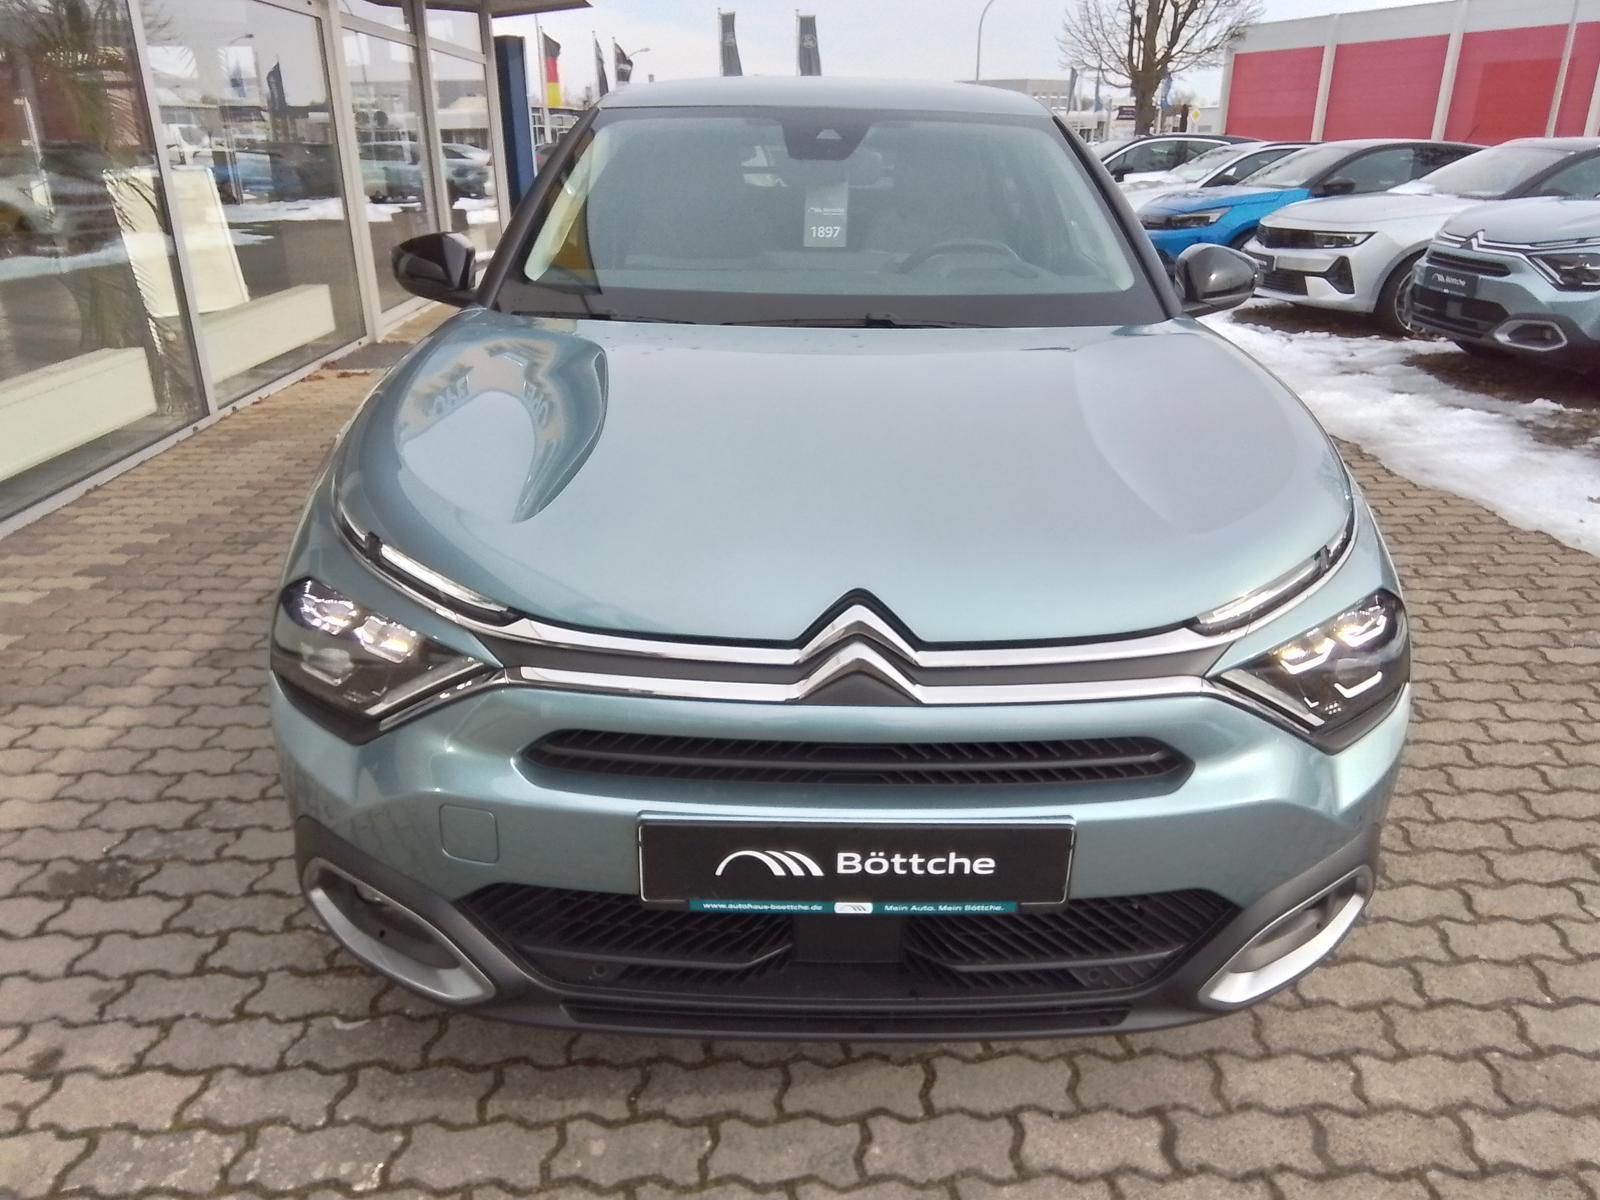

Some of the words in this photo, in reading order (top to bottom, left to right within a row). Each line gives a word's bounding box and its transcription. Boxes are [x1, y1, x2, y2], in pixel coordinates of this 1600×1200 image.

[810, 226, 841, 238] 1897
[837, 851, 996, 875] Böttche
[884, 904, 908, 912] Mein
[938, 904, 962, 912] Mein
